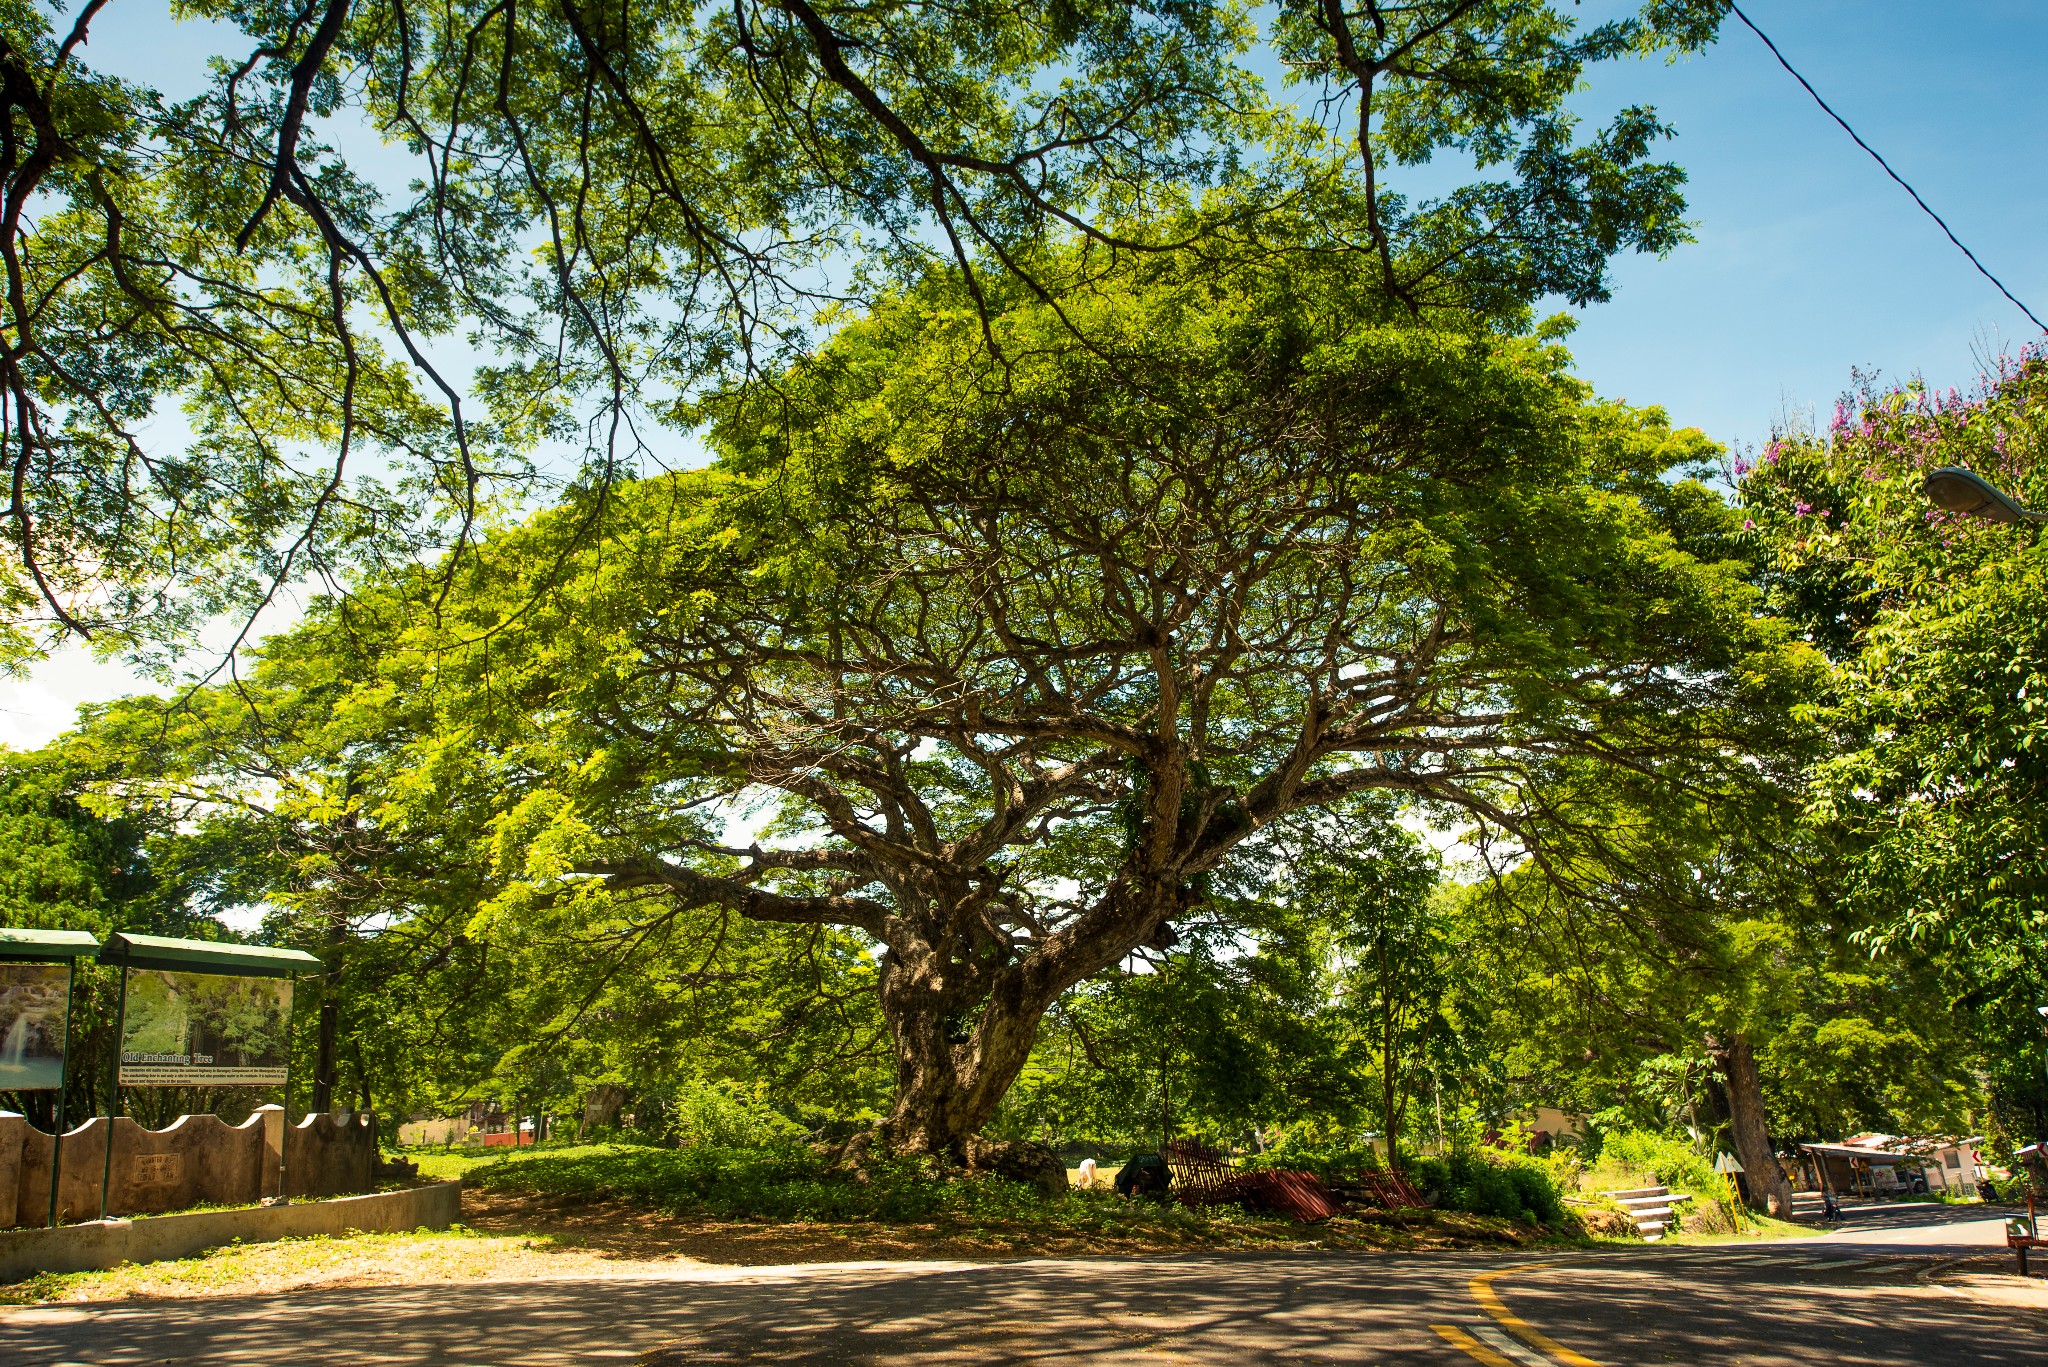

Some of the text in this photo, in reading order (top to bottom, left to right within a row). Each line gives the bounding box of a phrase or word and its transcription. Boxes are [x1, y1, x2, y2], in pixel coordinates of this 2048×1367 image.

[123, 1052, 213, 1065] Old Enchanting Tree
